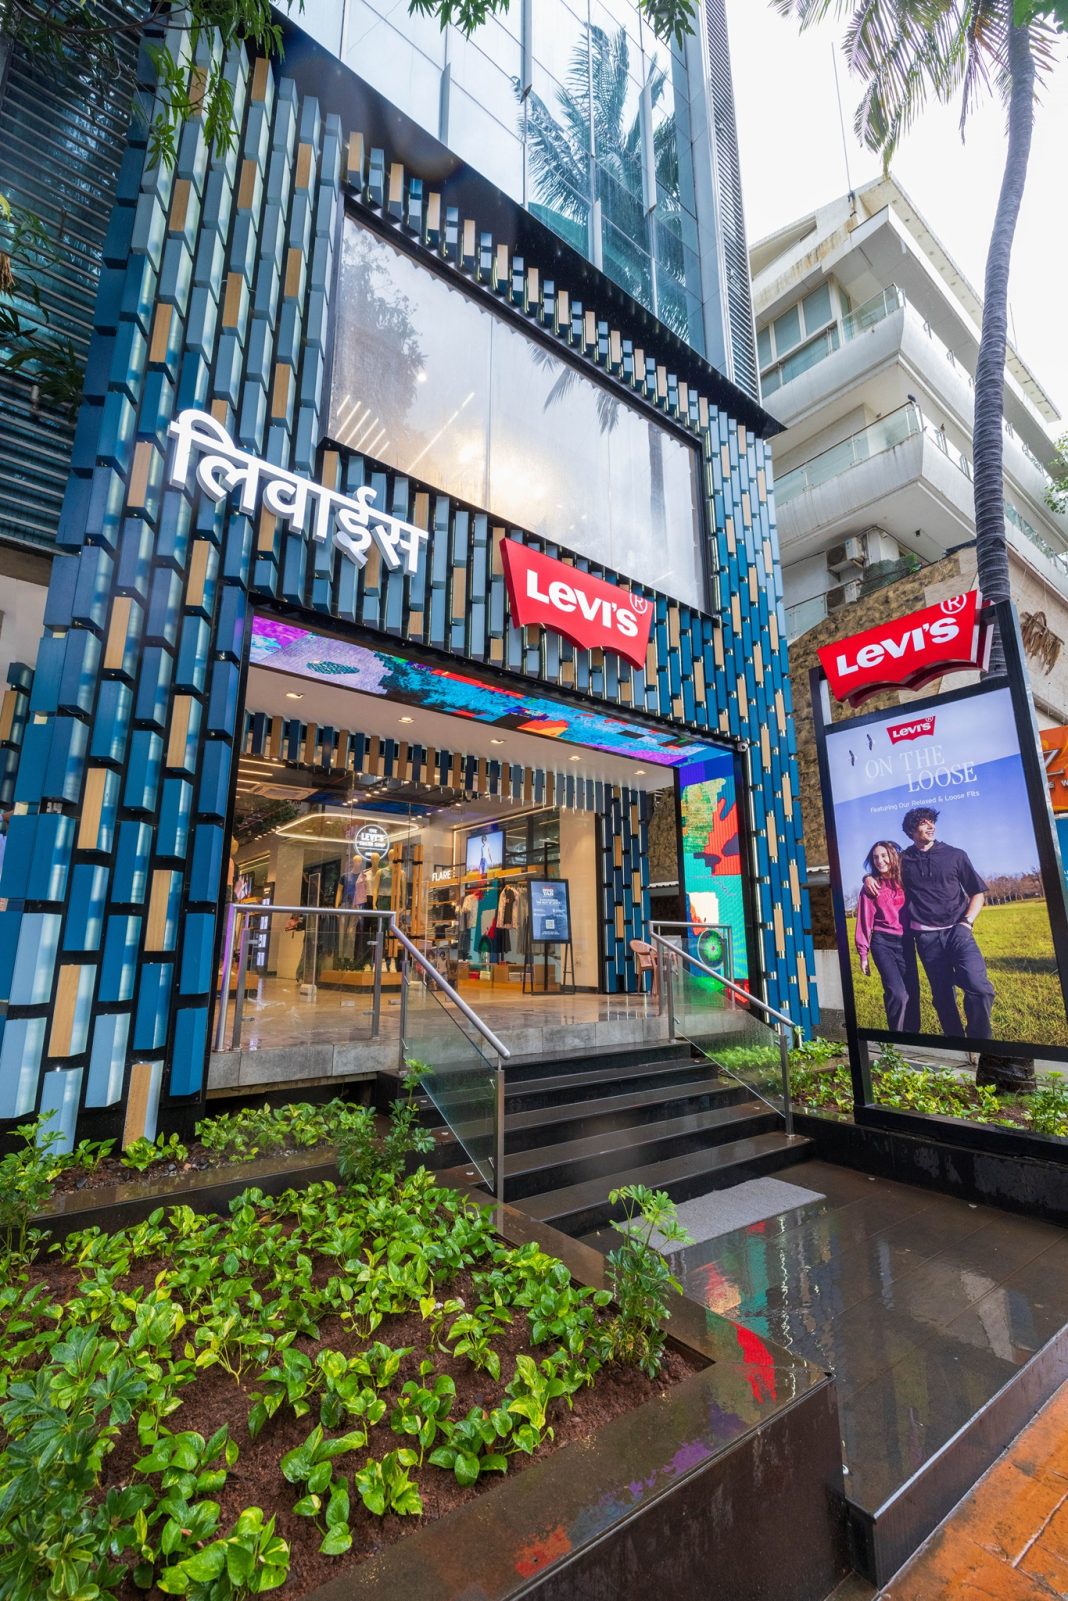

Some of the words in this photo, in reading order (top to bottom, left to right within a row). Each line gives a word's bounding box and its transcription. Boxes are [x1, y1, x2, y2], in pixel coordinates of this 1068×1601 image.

[168, 409, 428, 576] लिवाईस
[865, 756, 893, 778] ON
[900, 745, 945, 771] THE
[906, 761, 977, 793] LOOSE
[870, 804, 898, 813] Featuring
[911, 797, 937, 807] Relaxed
[432, 870, 451, 881] FLARE
